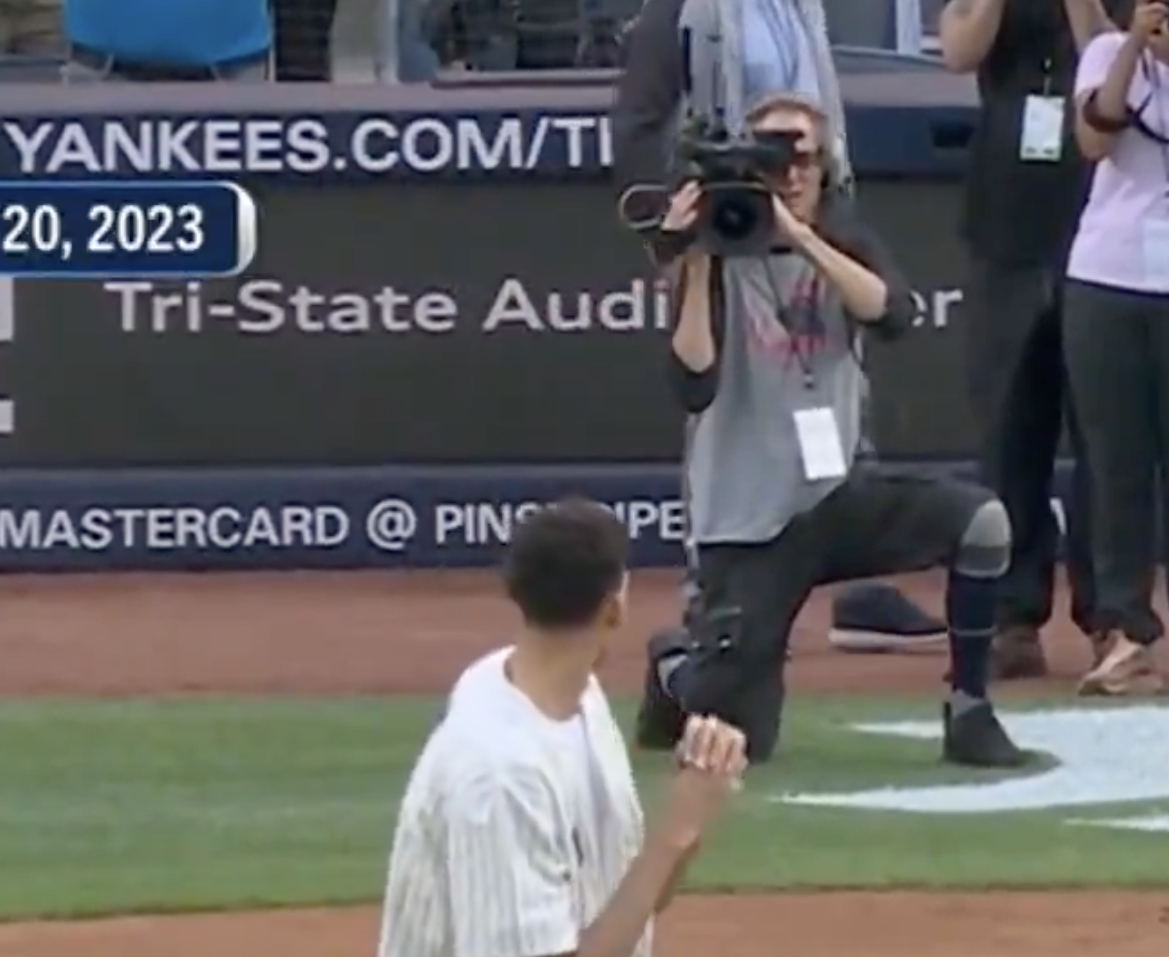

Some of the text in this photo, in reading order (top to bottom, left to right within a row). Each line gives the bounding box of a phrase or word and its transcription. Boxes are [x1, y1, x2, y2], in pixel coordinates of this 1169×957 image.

[3, 116, 614, 173] YANKEES.COM/TI
[104, 278, 674, 333] Tri-State Audi
[0, 505, 349, 549] MASTERCARD
[366, 499, 416, 551] @
